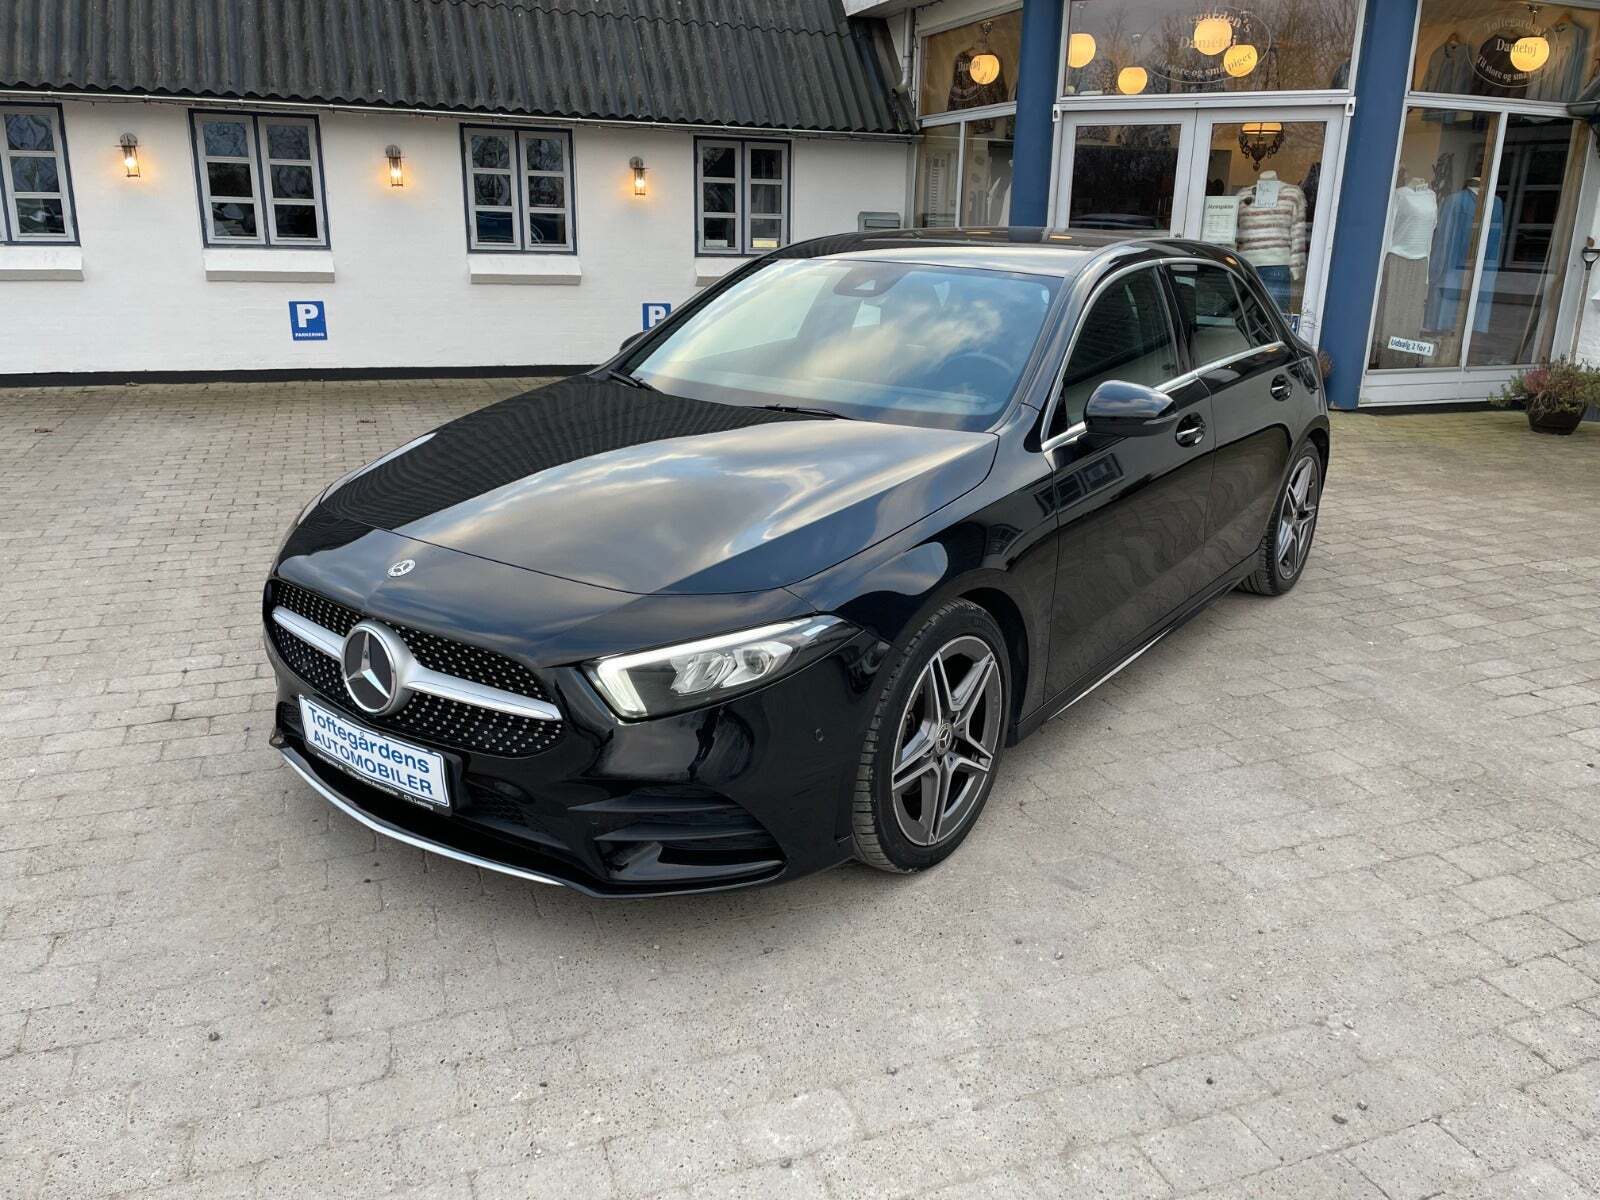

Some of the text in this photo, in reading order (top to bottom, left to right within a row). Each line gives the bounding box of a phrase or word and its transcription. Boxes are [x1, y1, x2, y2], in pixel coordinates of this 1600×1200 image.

[296, 303, 319, 328] P
[648, 305, 667, 328] P
[308, 706, 430, 774] Toftegårdens
[313, 731, 433, 795] AUTOMOBILER
